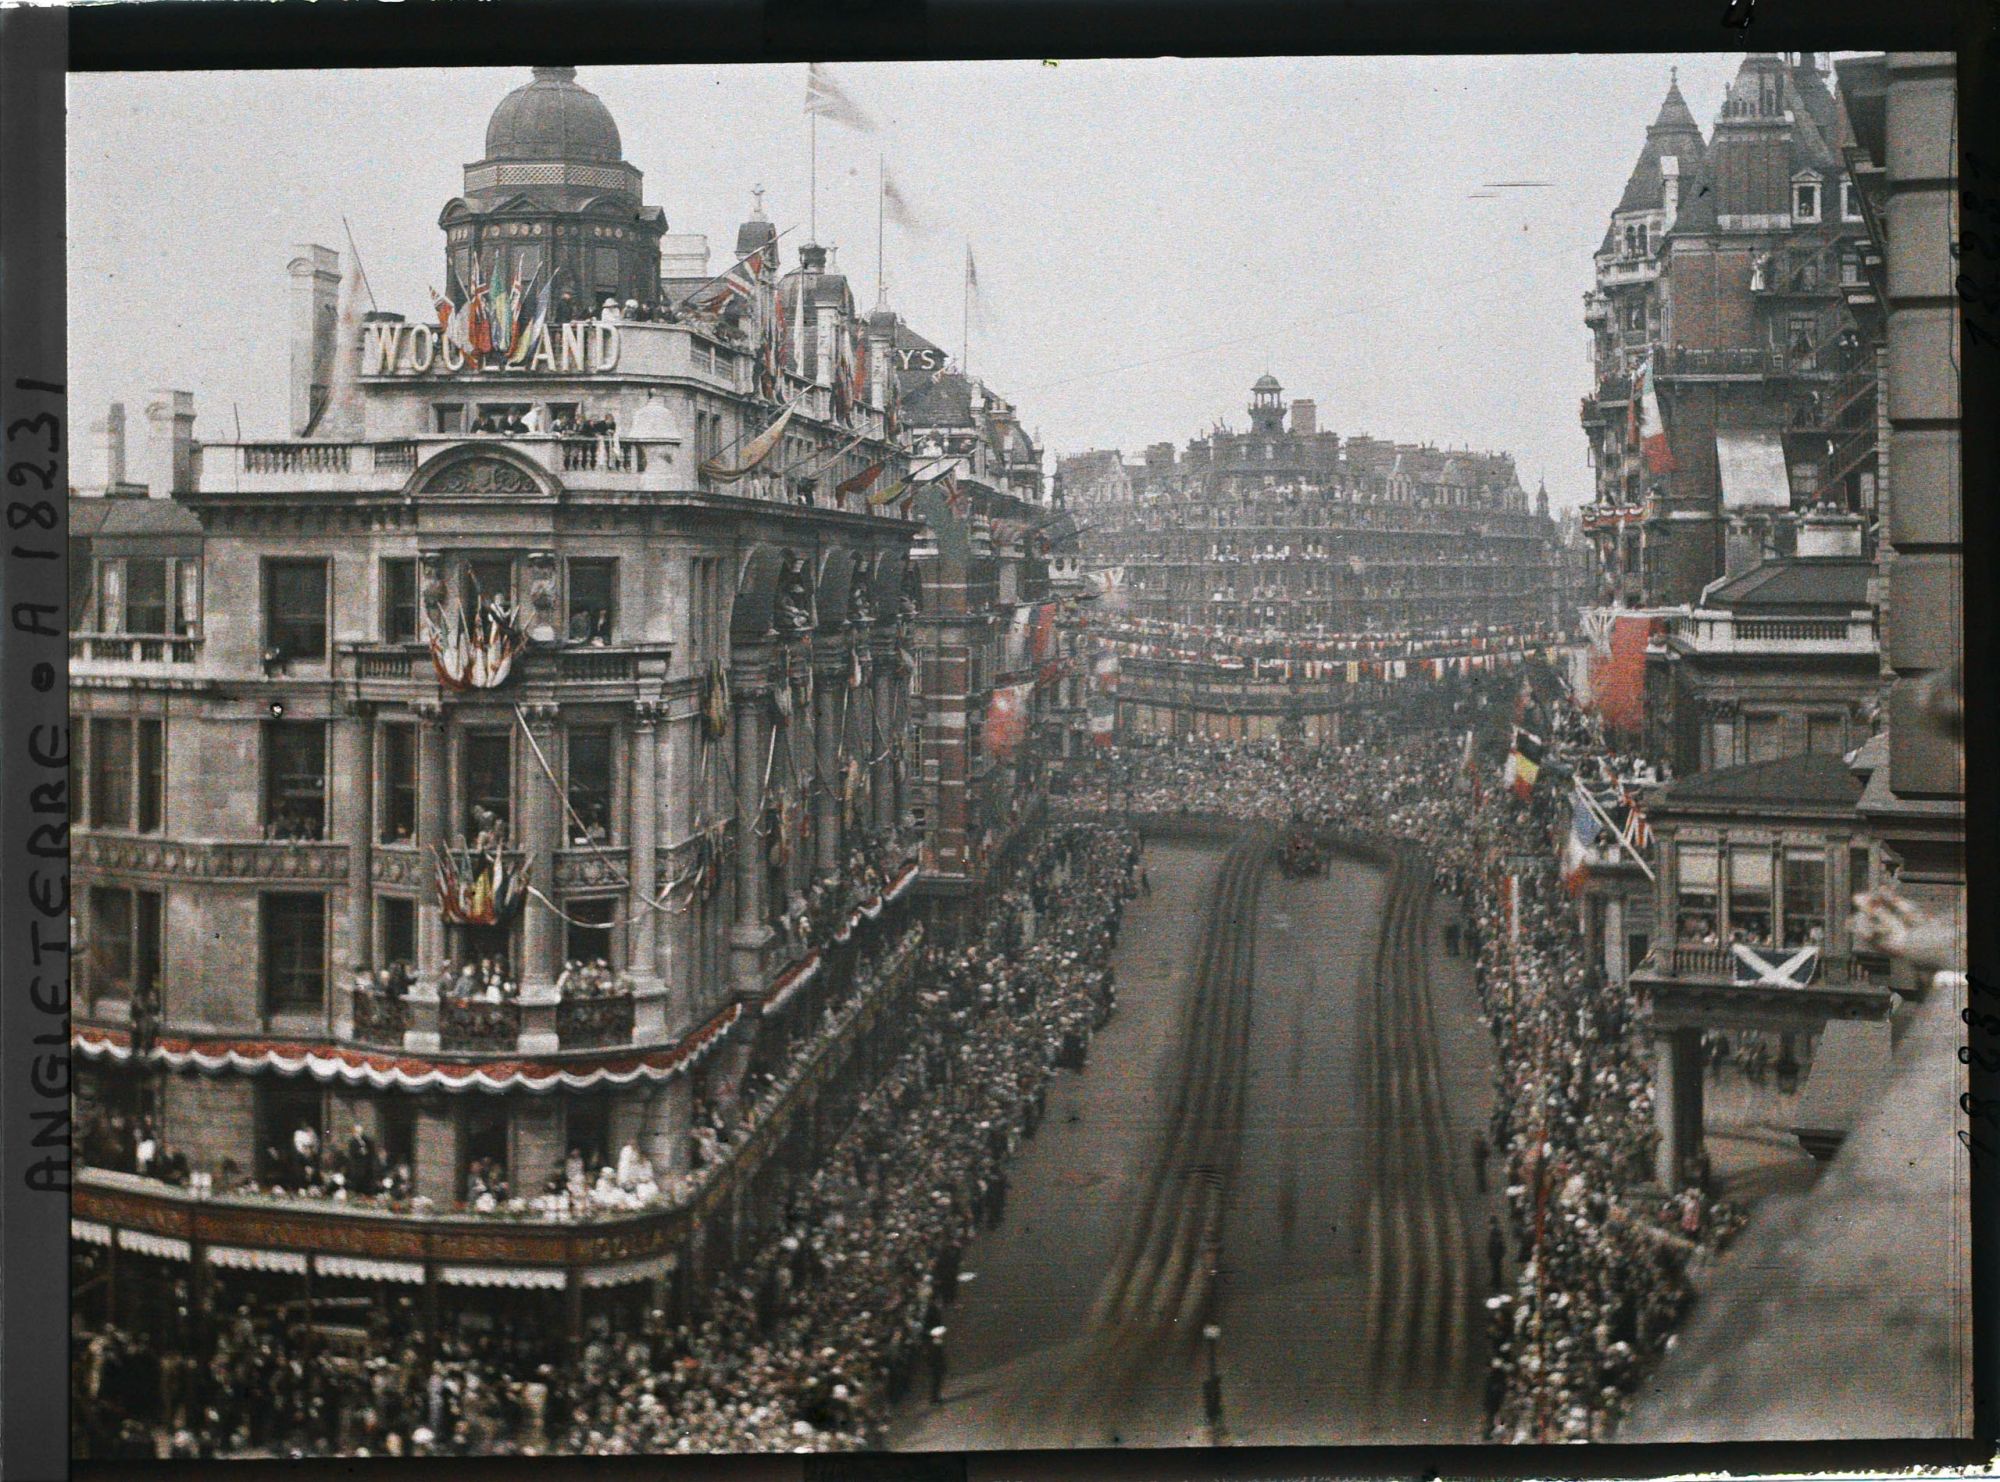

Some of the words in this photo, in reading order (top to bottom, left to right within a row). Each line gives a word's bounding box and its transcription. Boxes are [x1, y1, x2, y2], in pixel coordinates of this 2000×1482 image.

[7, 378, 65, 560] 18231
[12, 602, 61, 636] A
[25, 724, 70, 1192] ANGLETERRE
